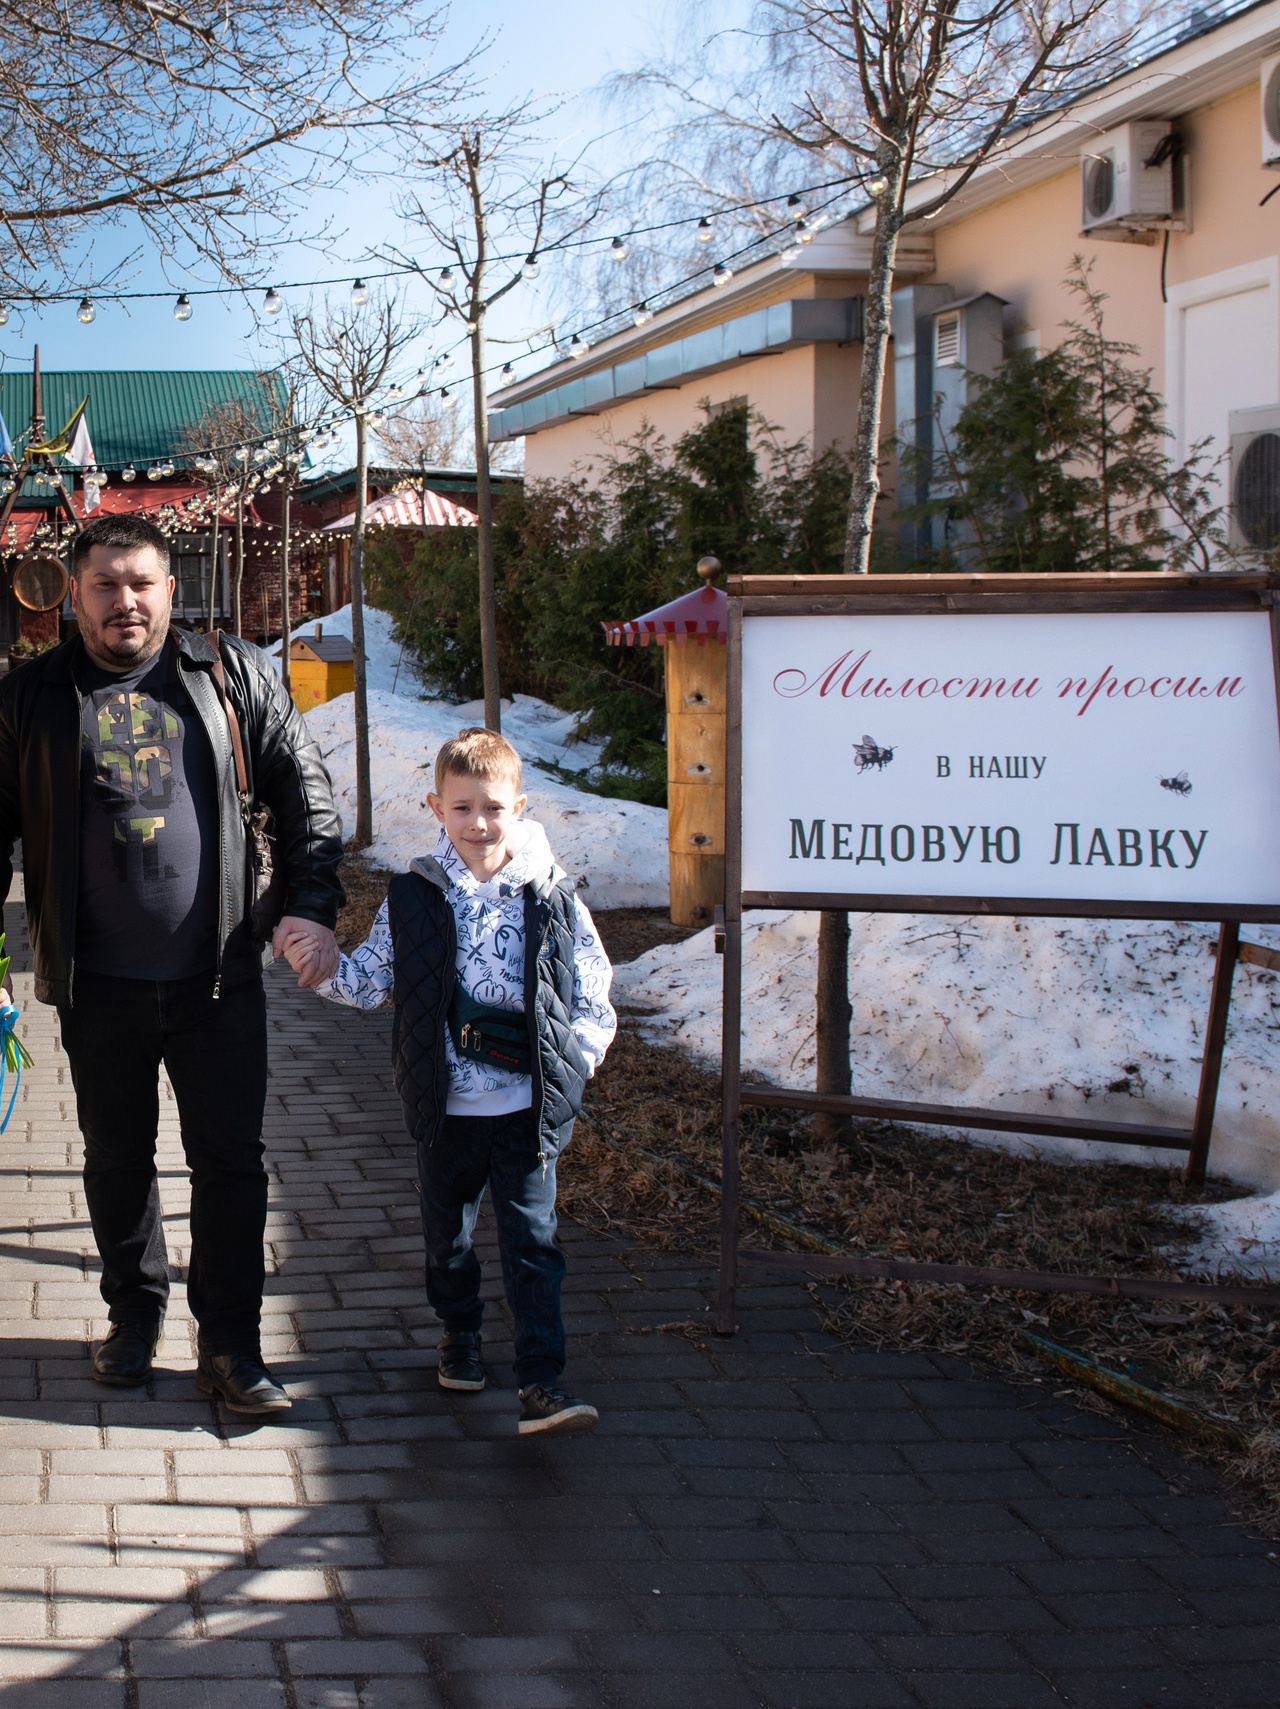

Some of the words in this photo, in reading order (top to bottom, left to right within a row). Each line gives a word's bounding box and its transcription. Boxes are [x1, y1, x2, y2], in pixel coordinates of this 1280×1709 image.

[773, 649, 1042, 698] Милости
[1056, 665, 1246, 716] просим
[489, 1049, 519, 1065] Sport
